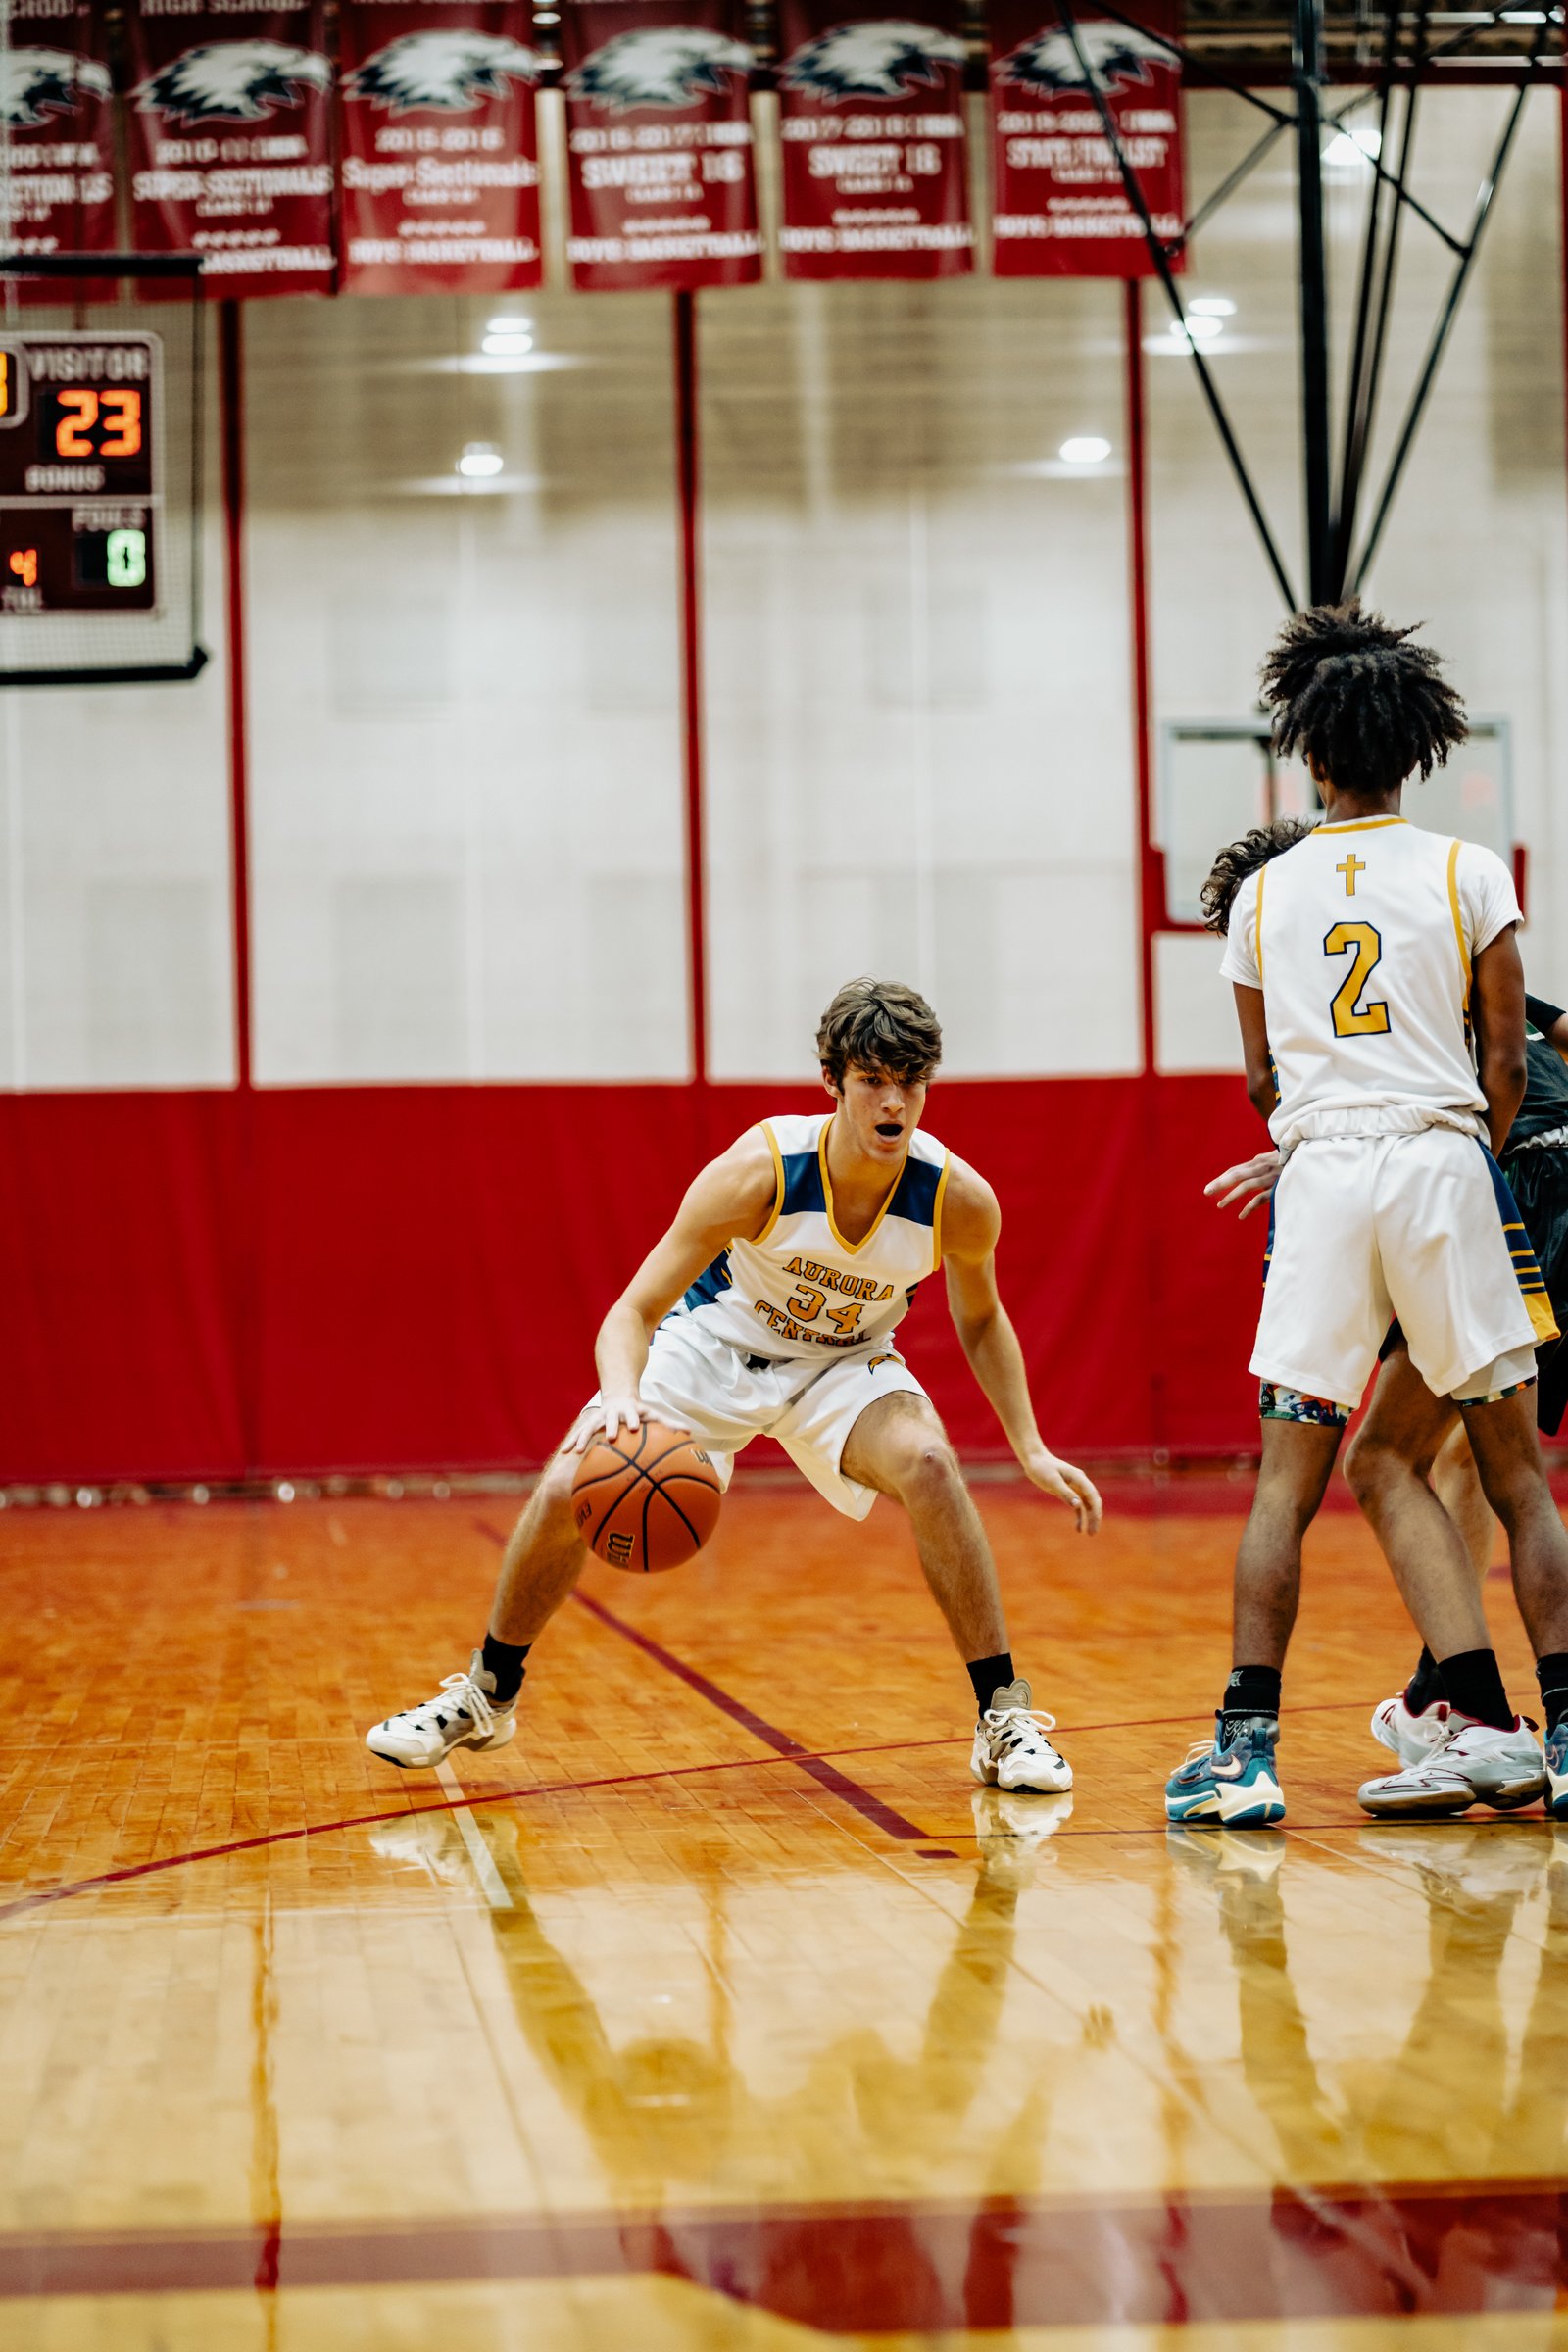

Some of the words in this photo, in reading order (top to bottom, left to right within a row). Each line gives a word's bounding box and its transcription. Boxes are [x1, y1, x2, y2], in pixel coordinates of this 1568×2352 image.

[26, 346, 149, 382] VISITOR
[56, 389, 141, 457] 23
[24, 464, 106, 493] BONUS
[9, 549, 37, 587] 4
[107, 529, 146, 587] 0
[1323, 921, 1392, 1038] 2
[782, 1256, 894, 1301] AURORA
[786, 1283, 865, 1334] 34
